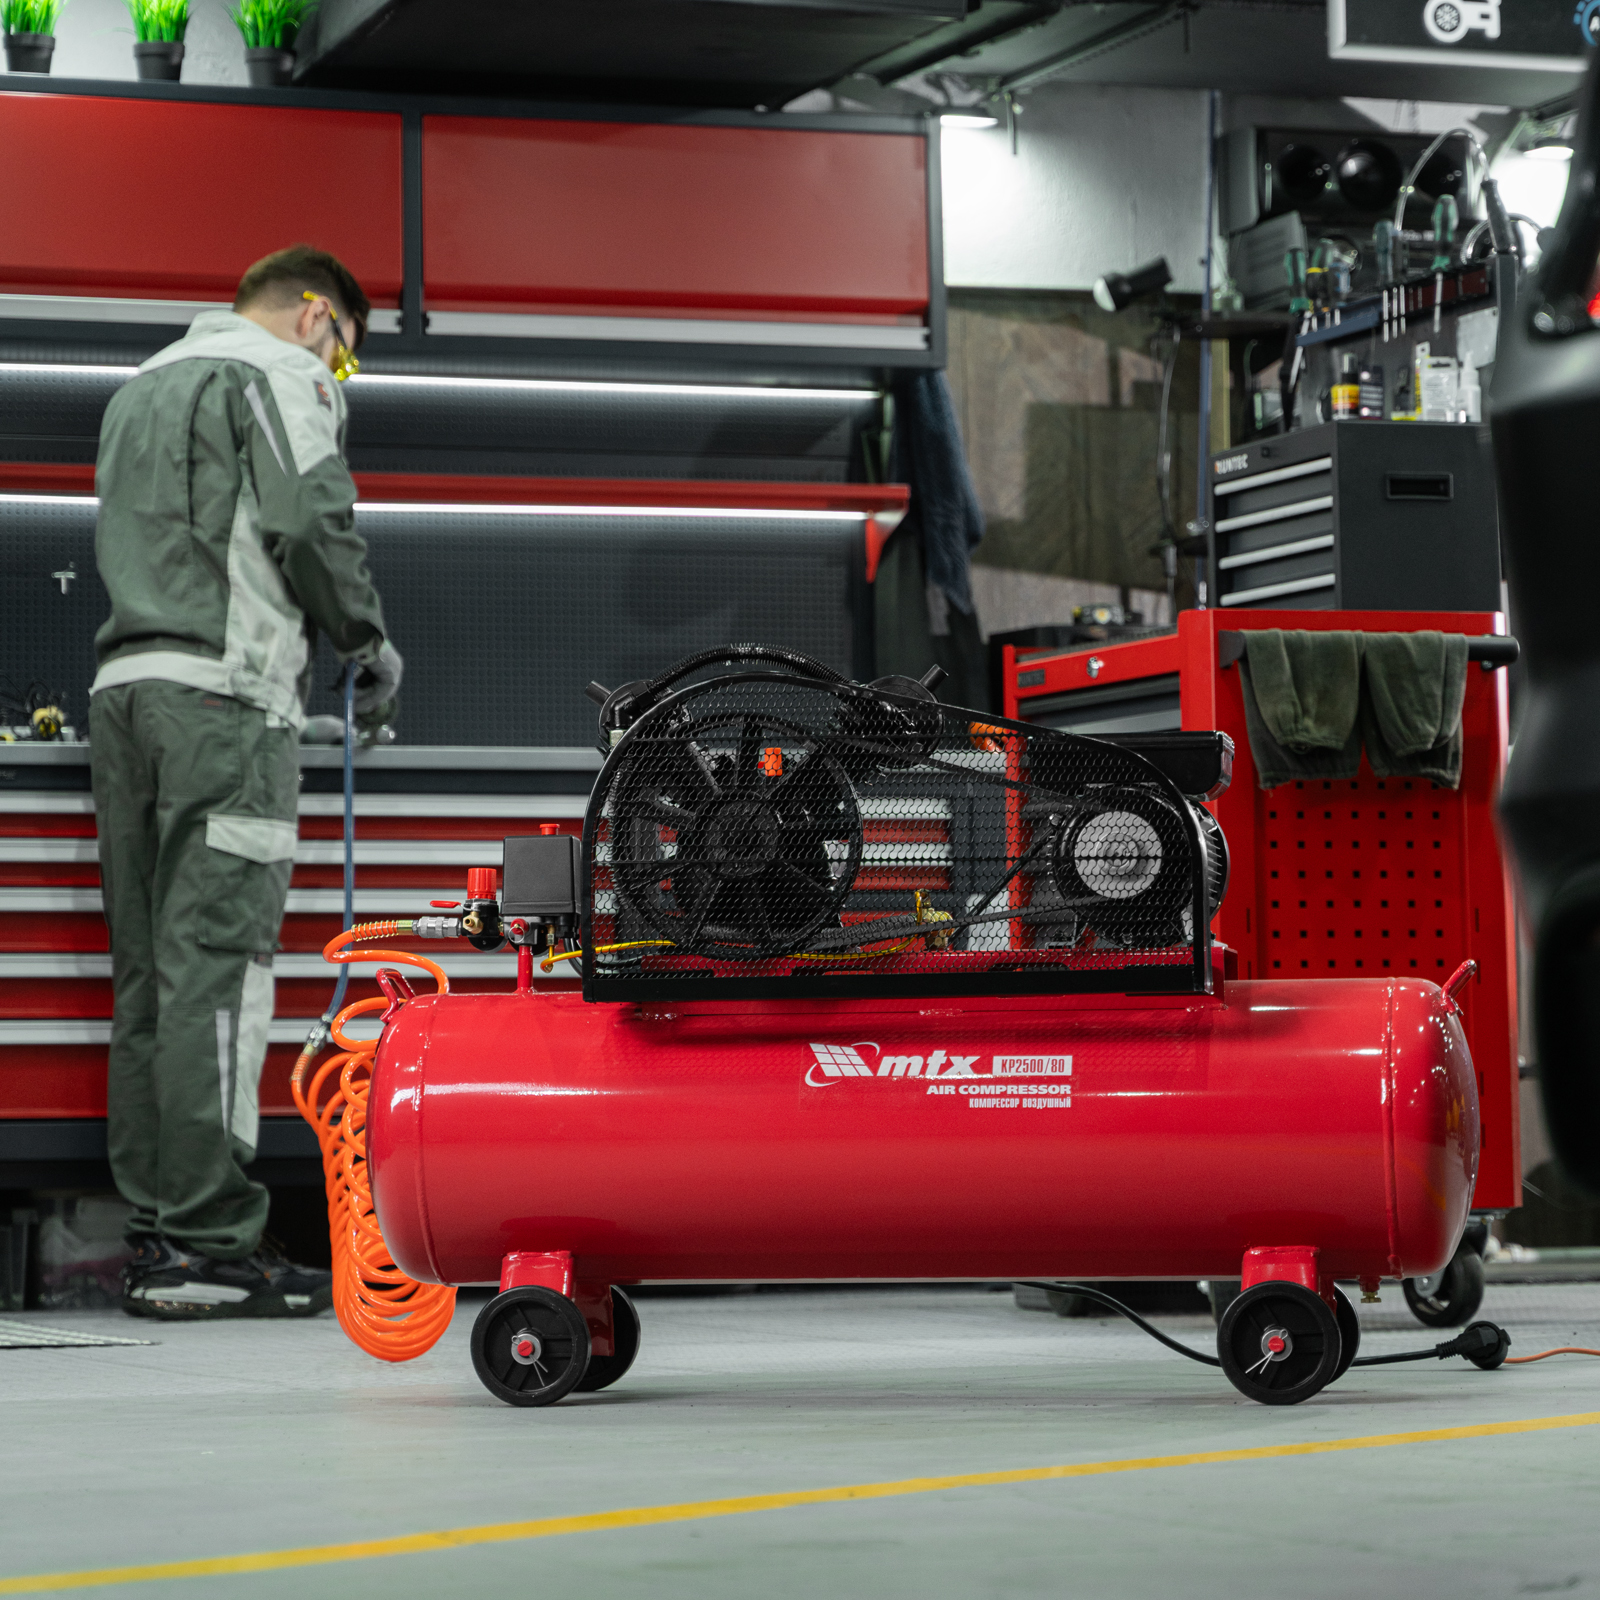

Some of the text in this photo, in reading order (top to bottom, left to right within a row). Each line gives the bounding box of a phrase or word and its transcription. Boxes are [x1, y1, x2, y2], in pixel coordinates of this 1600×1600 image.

[876, 1050, 1065, 1077] mtx KP2500/80
[926, 1084, 1071, 1095] AIR COMPRESSOR
[969, 1097, 1071, 1109] КОМПРЕССОР ВОЗДУШНЫЙ
